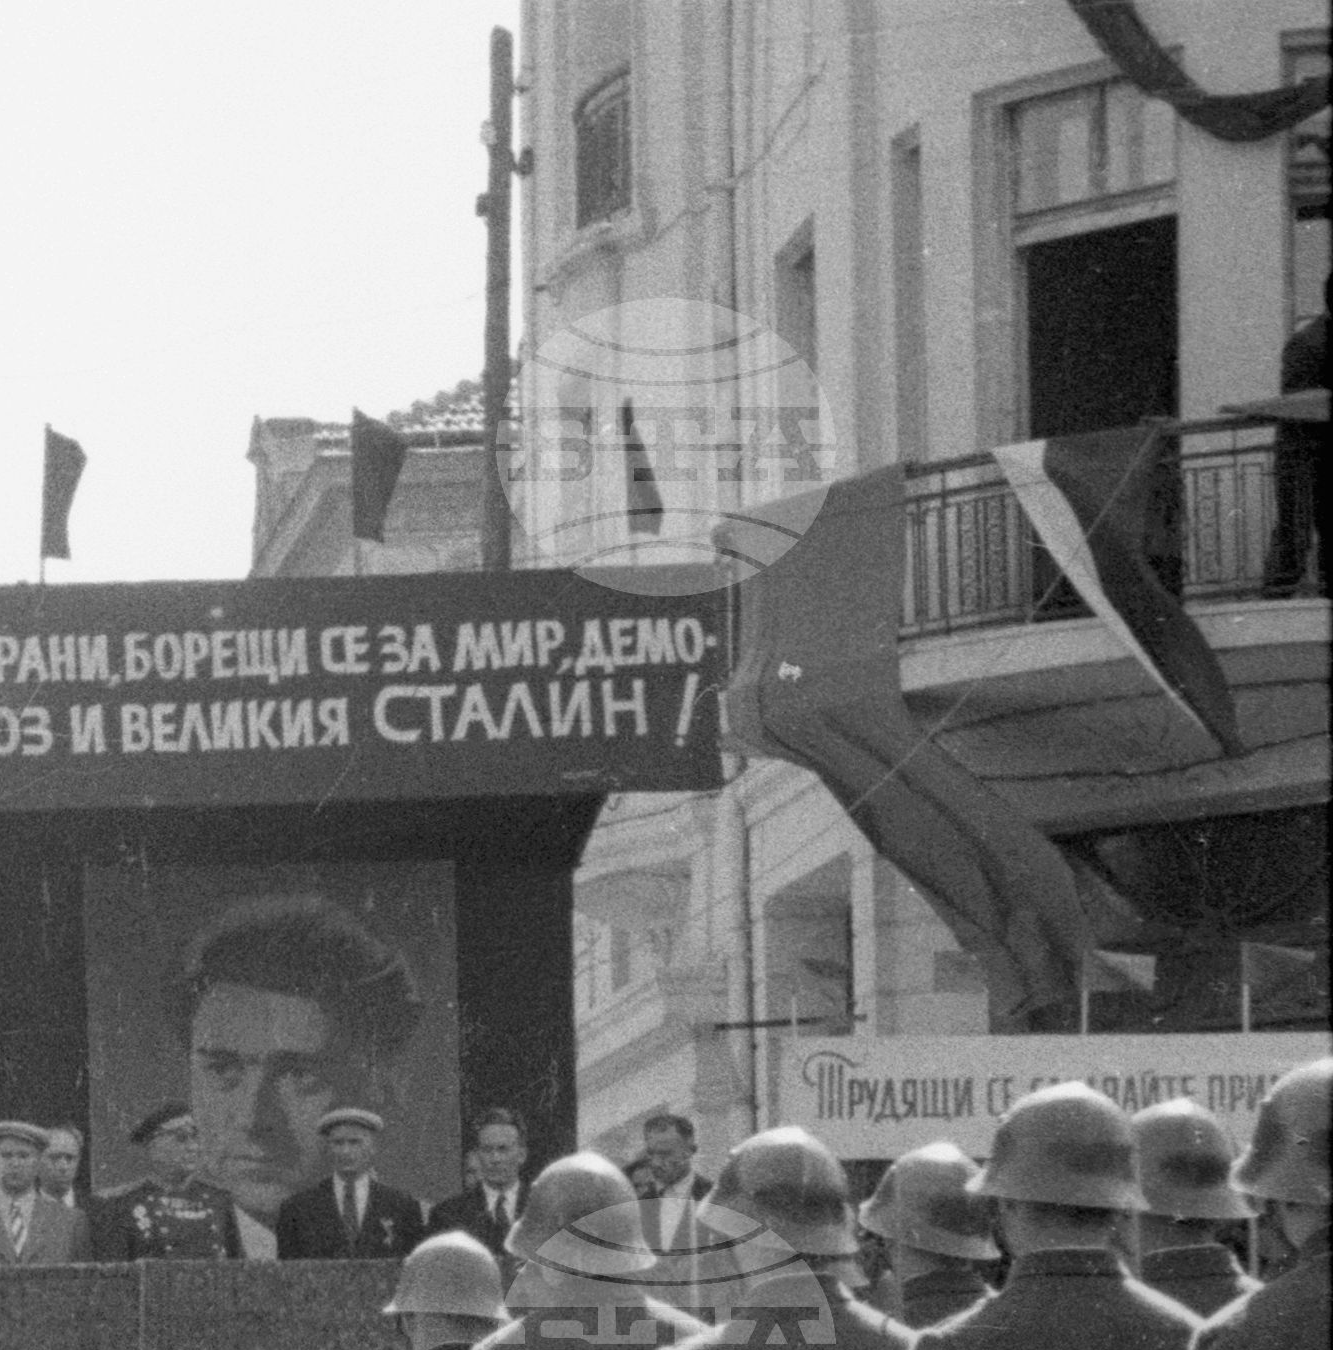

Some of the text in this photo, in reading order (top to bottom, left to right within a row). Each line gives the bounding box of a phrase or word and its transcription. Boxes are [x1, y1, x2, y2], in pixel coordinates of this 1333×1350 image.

[319, 625, 371, 675] СЕ
[379, 623, 441, 674] ЗА
[69, 703, 107, 755] И
[120, 697, 351, 754] ВЕЛИКИЯ
[1206, 1074, 1281, 1113] ПРИ
